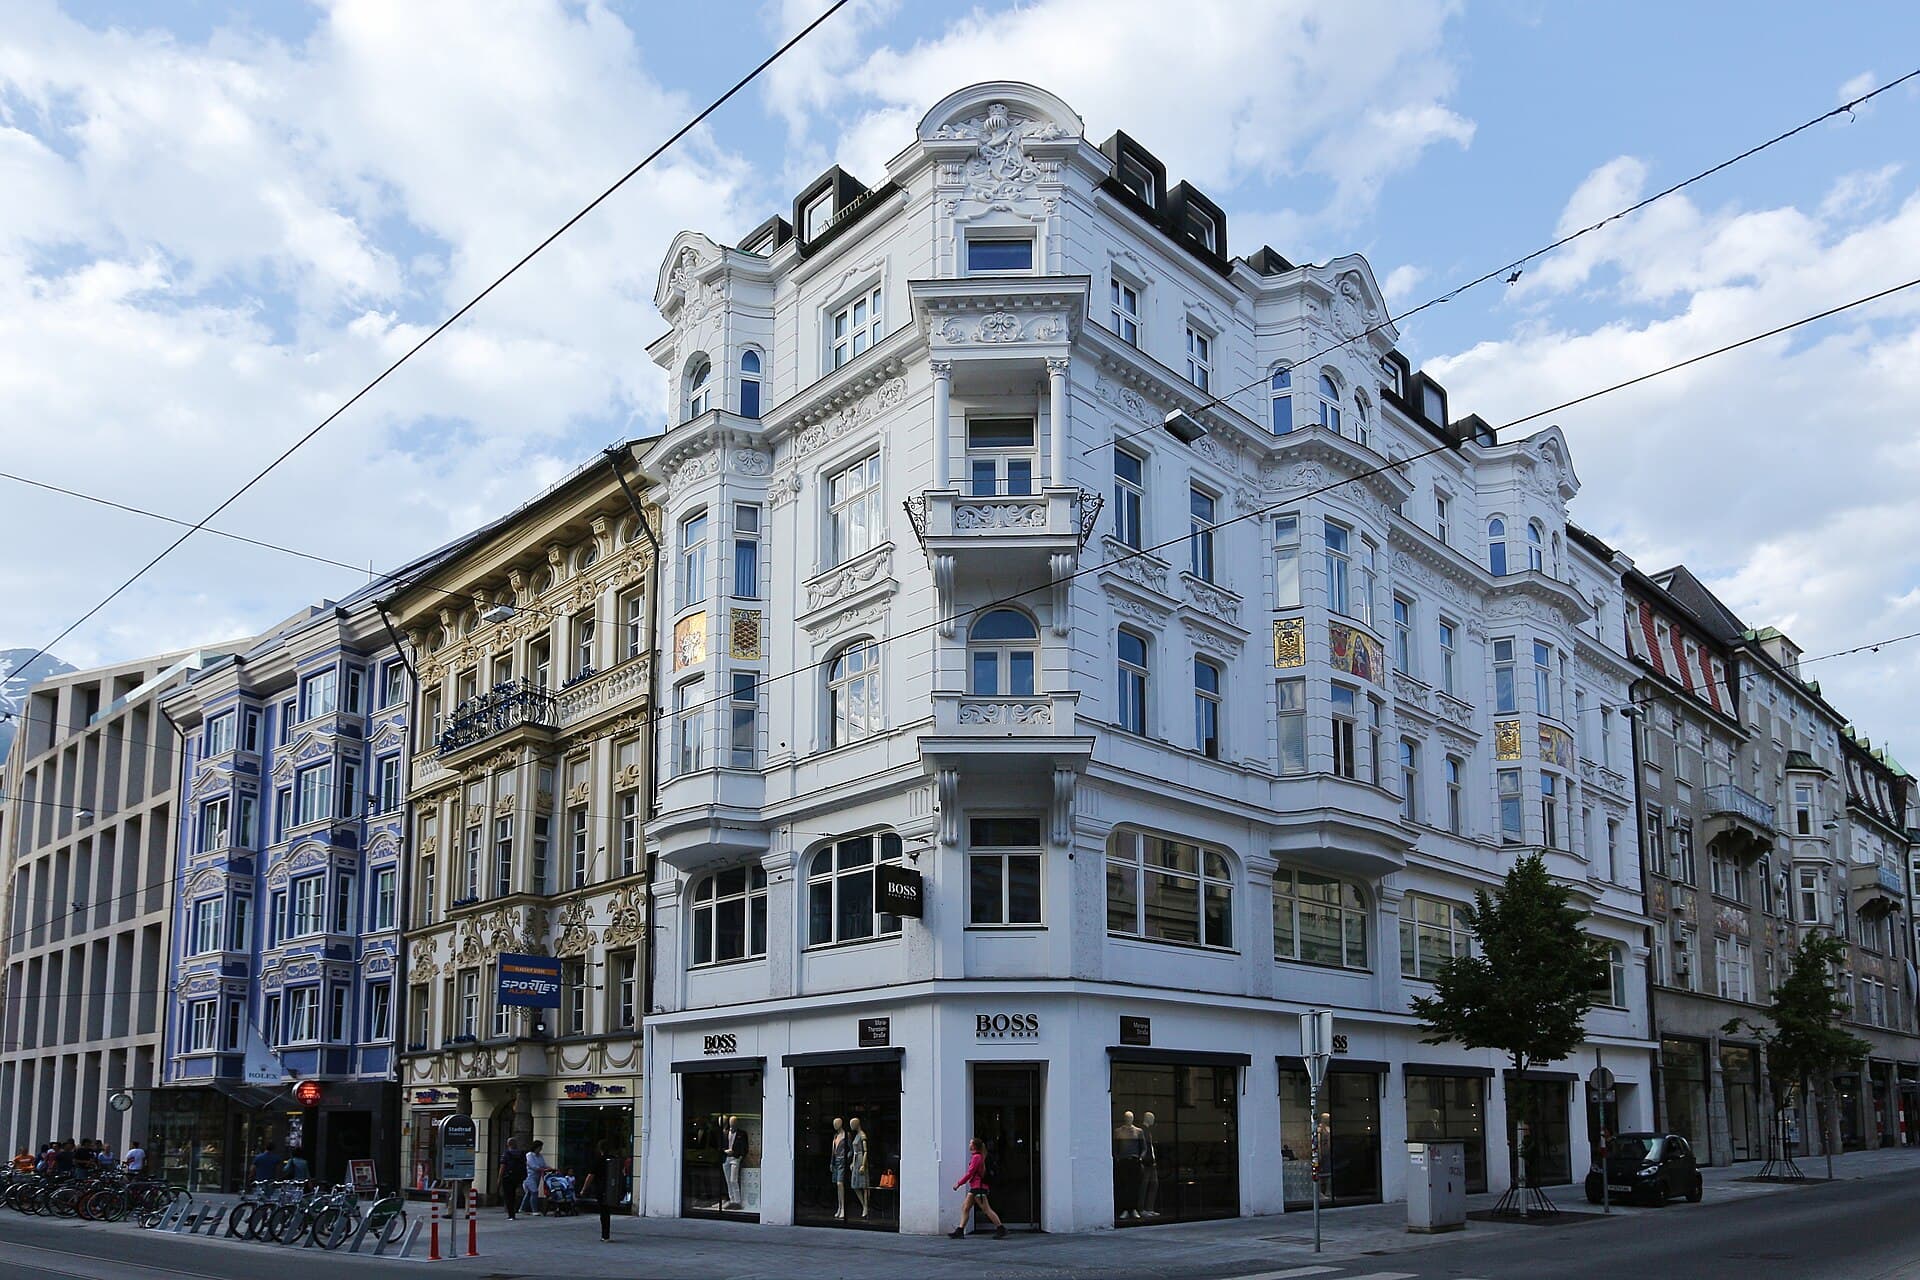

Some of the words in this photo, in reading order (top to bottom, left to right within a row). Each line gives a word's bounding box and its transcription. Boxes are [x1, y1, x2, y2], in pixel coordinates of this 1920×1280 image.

[888, 882, 917, 896] BOSS
[501, 979, 558, 994] SPORTLER
[975, 1013, 1039, 1031] BOSS
[704, 1033, 736, 1049] BOSS
